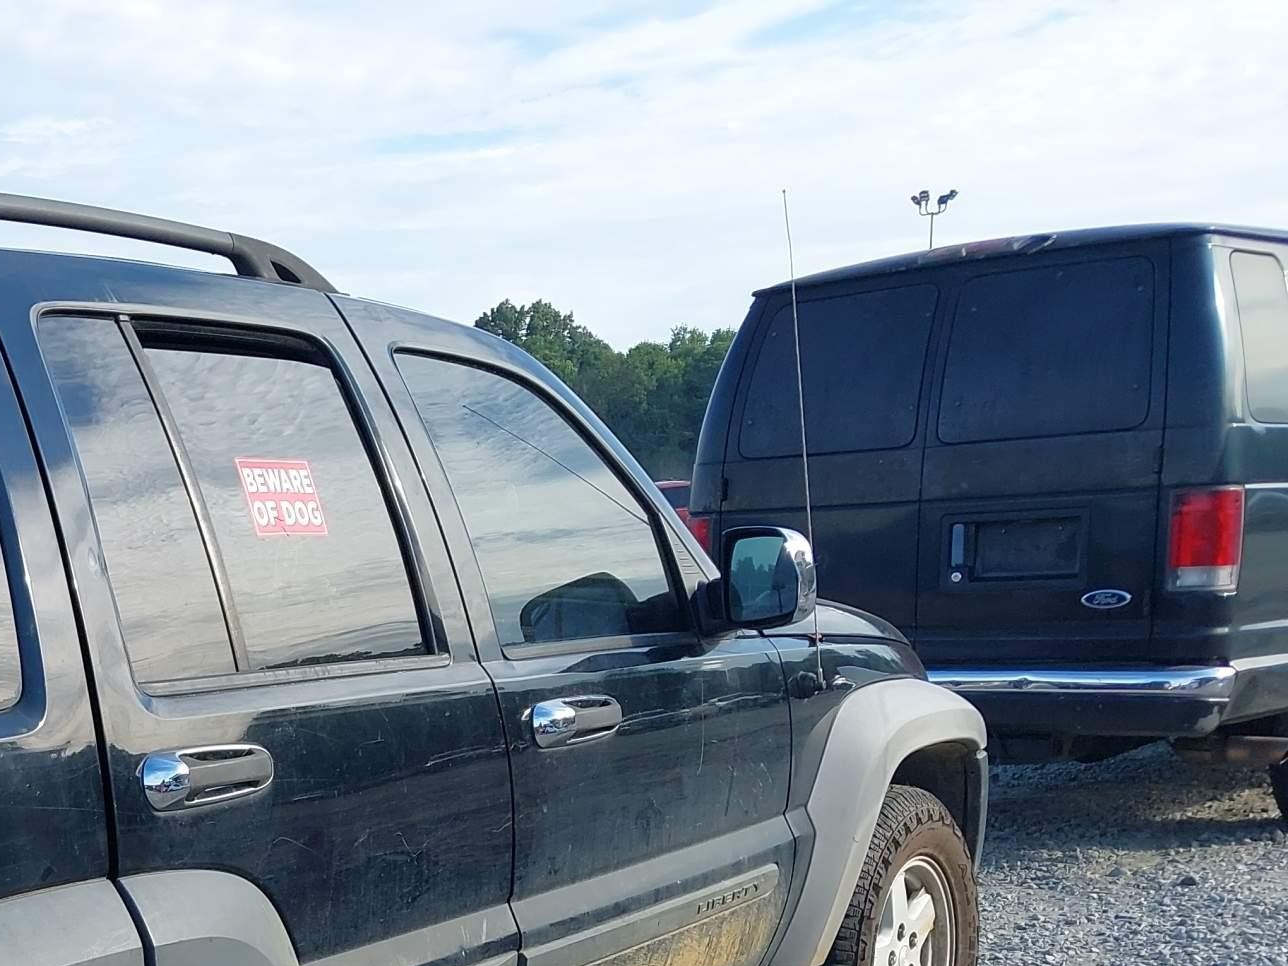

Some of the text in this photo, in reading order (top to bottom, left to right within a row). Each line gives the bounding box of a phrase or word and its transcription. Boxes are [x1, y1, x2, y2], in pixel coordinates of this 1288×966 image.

[242, 467, 314, 493] BEWARE
[253, 500, 323, 526] OF DOG
[696, 883, 760, 915] LIBERTY
